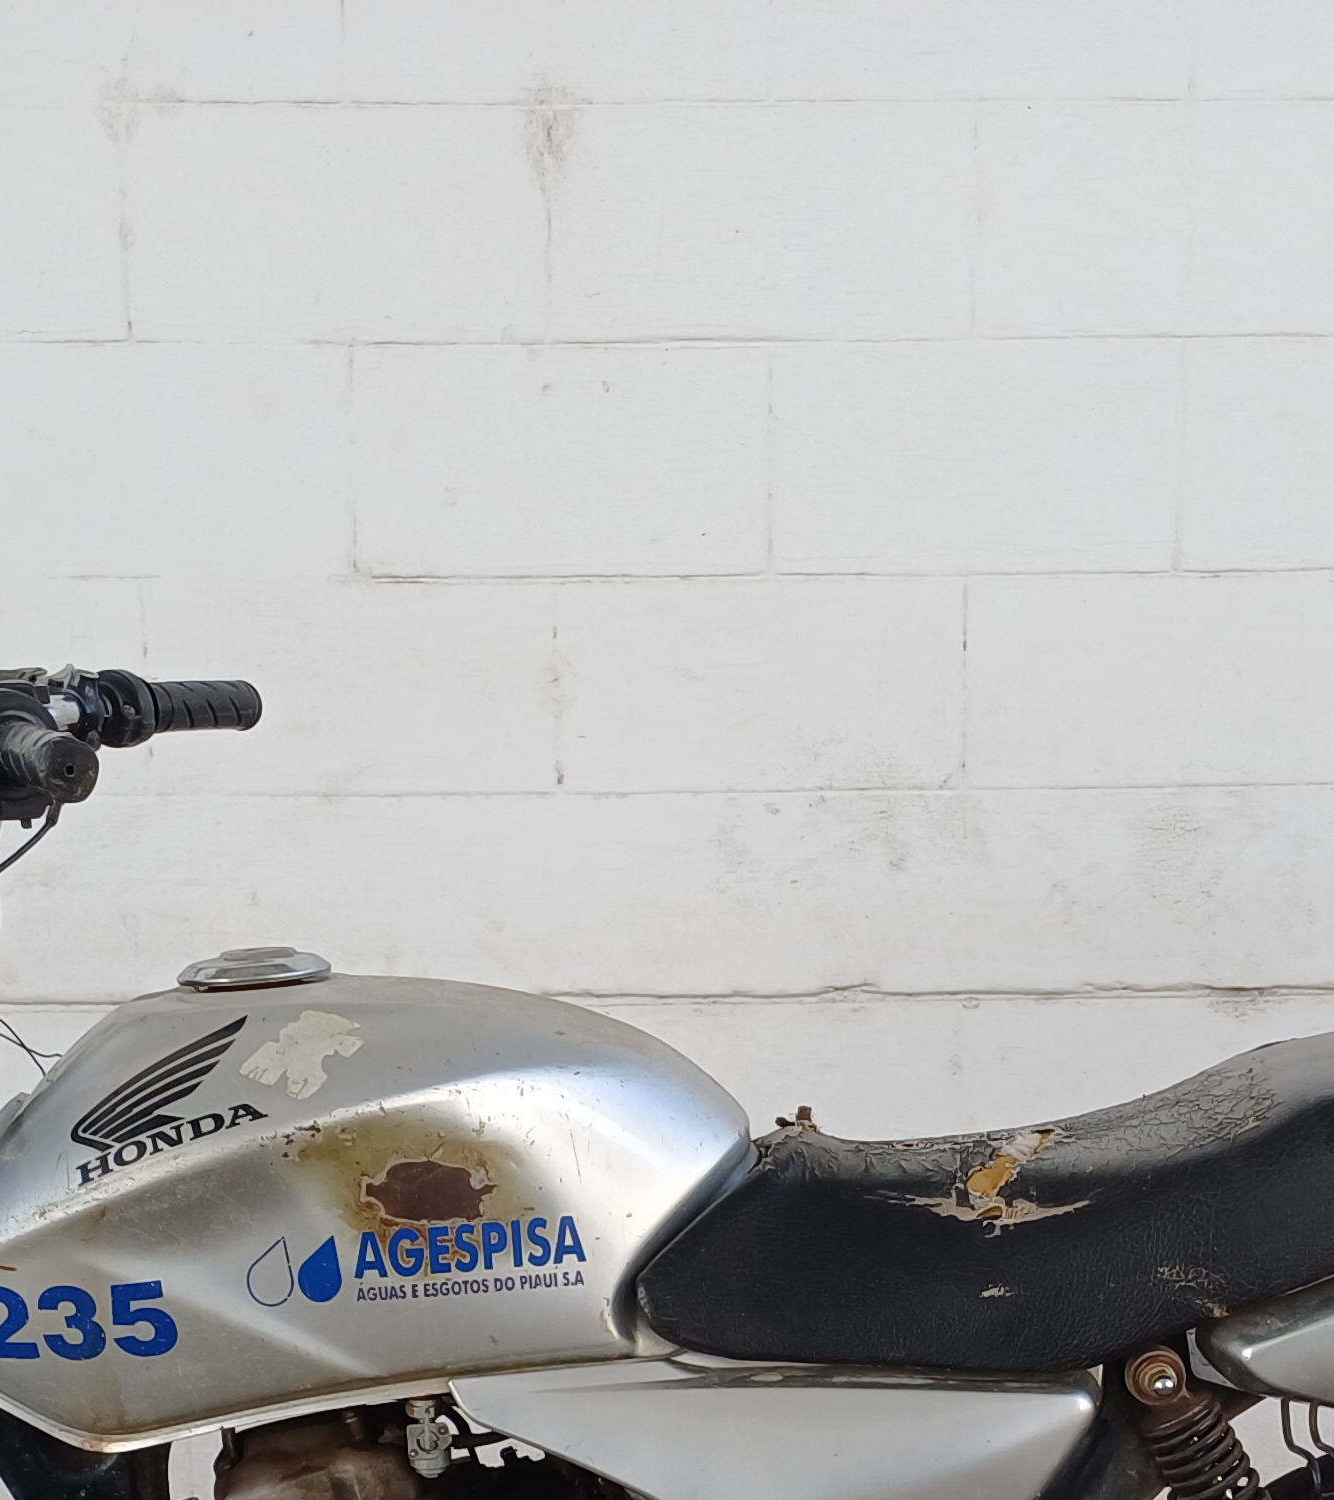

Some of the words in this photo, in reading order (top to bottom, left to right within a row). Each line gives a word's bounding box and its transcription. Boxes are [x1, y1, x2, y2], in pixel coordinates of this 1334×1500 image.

[76, 1103, 269, 1187] HONDA
[354, 1215, 587, 1279] AGESPISA
[357, 1282, 407, 1302] ÁGUAS
[412, 1284, 419, 1298] E
[424, 1278, 489, 1298] ESGOTOS
[494, 1276, 515, 1292] DO
[562, 1270, 584, 1287] S.A
